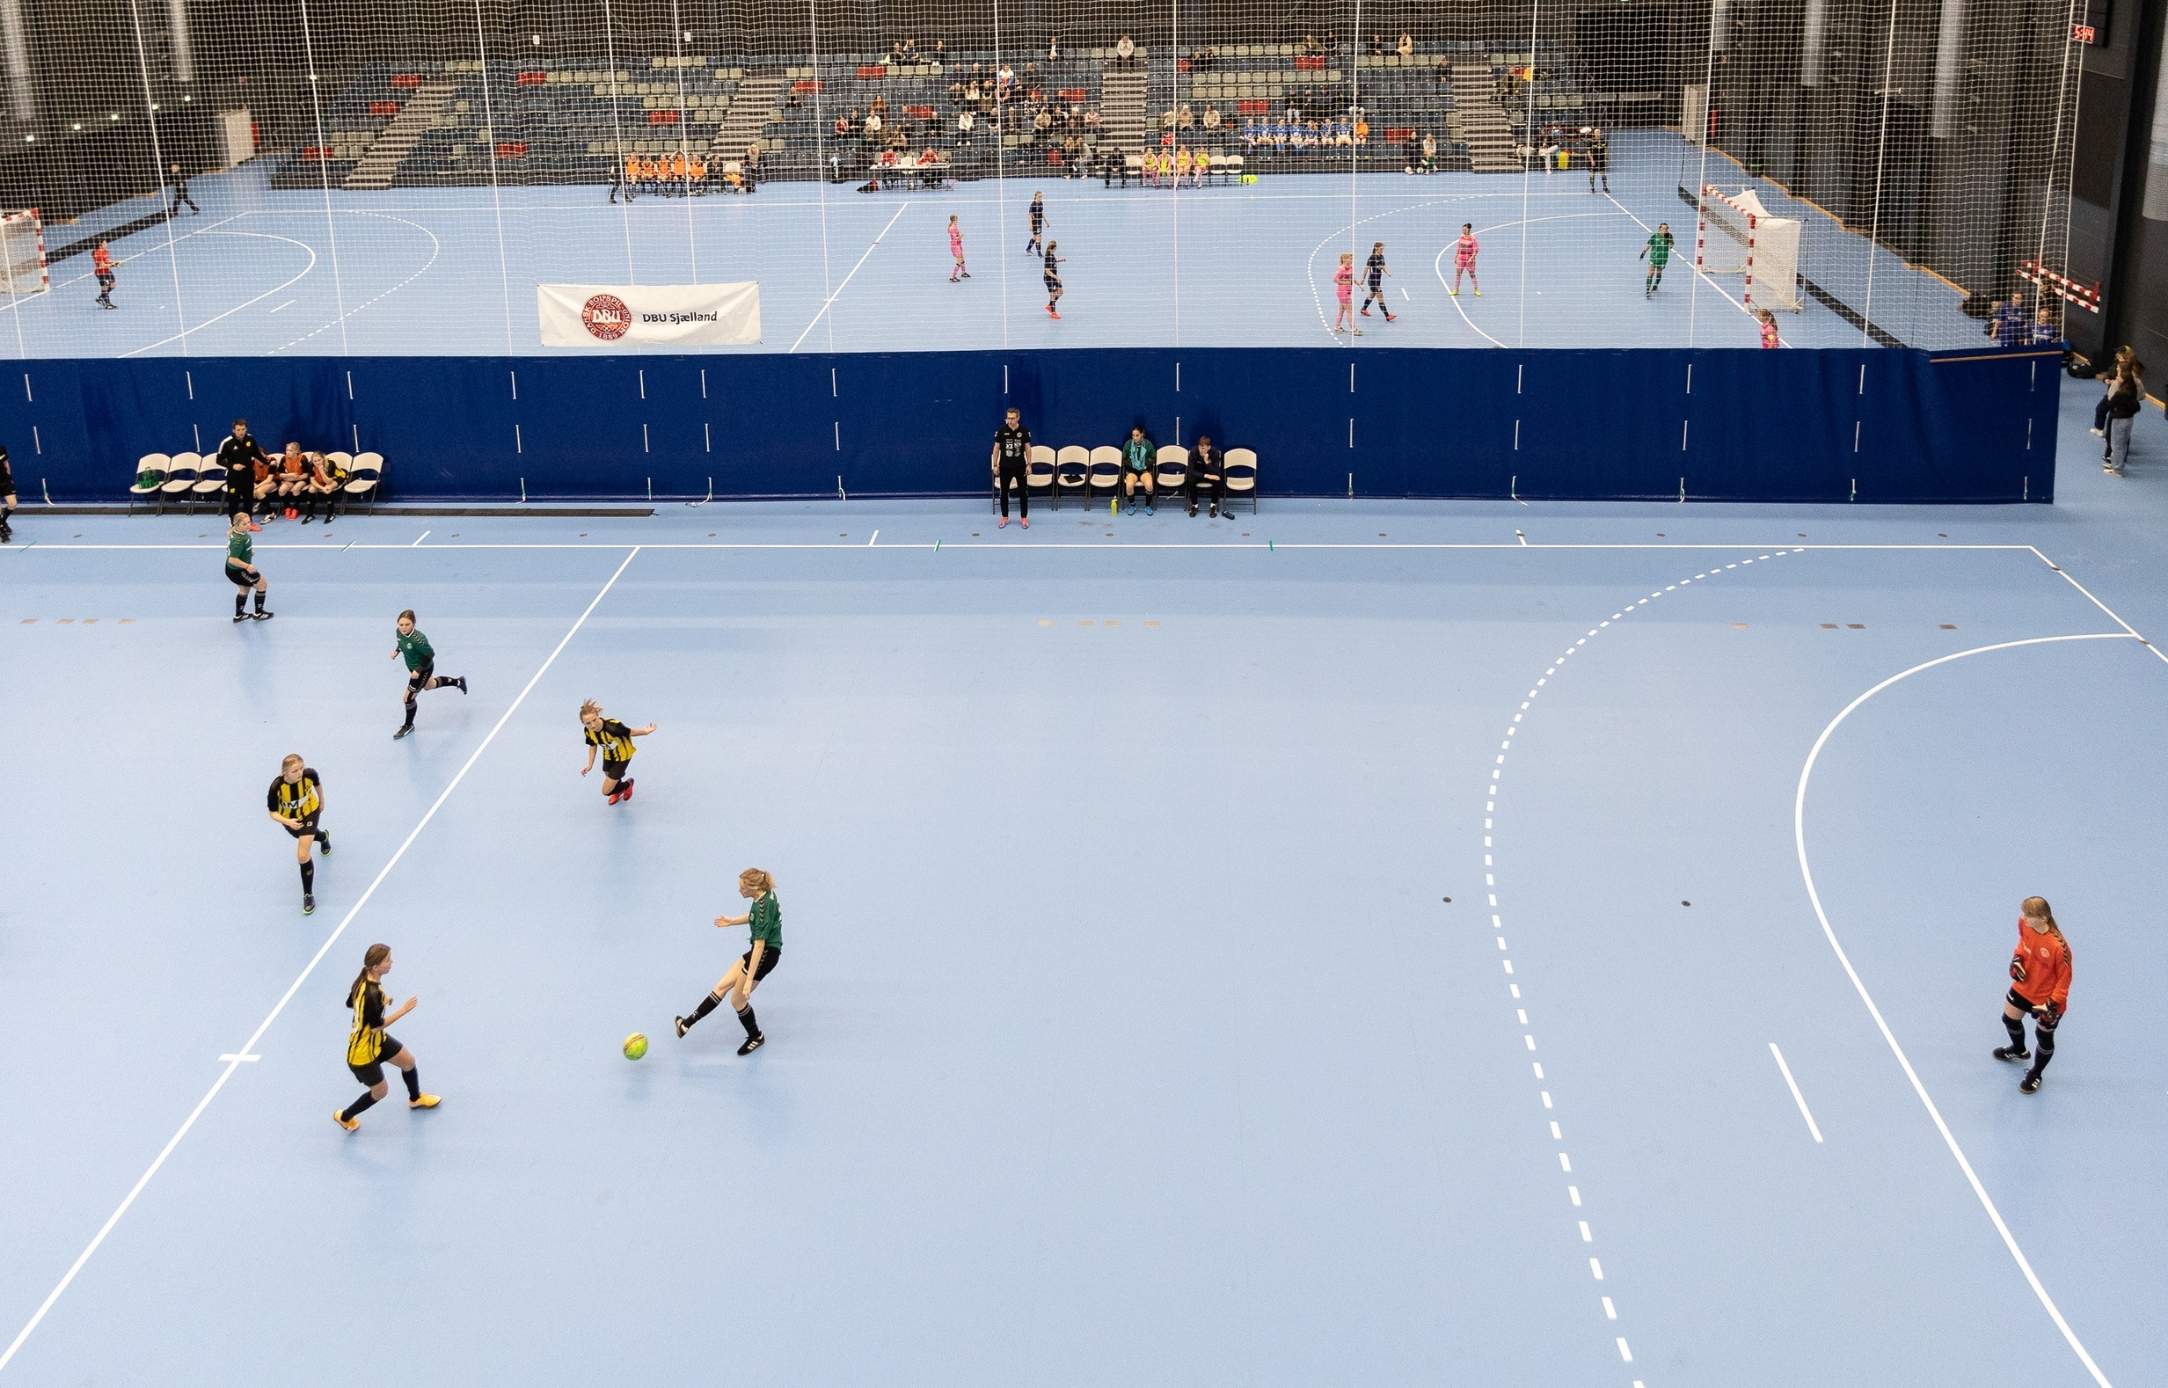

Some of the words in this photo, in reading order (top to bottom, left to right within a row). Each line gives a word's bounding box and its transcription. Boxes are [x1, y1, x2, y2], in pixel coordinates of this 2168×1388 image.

[592, 309, 622, 324] DBU
[642, 313, 667, 322] DBU
[669, 311, 717, 325] Sjælland
